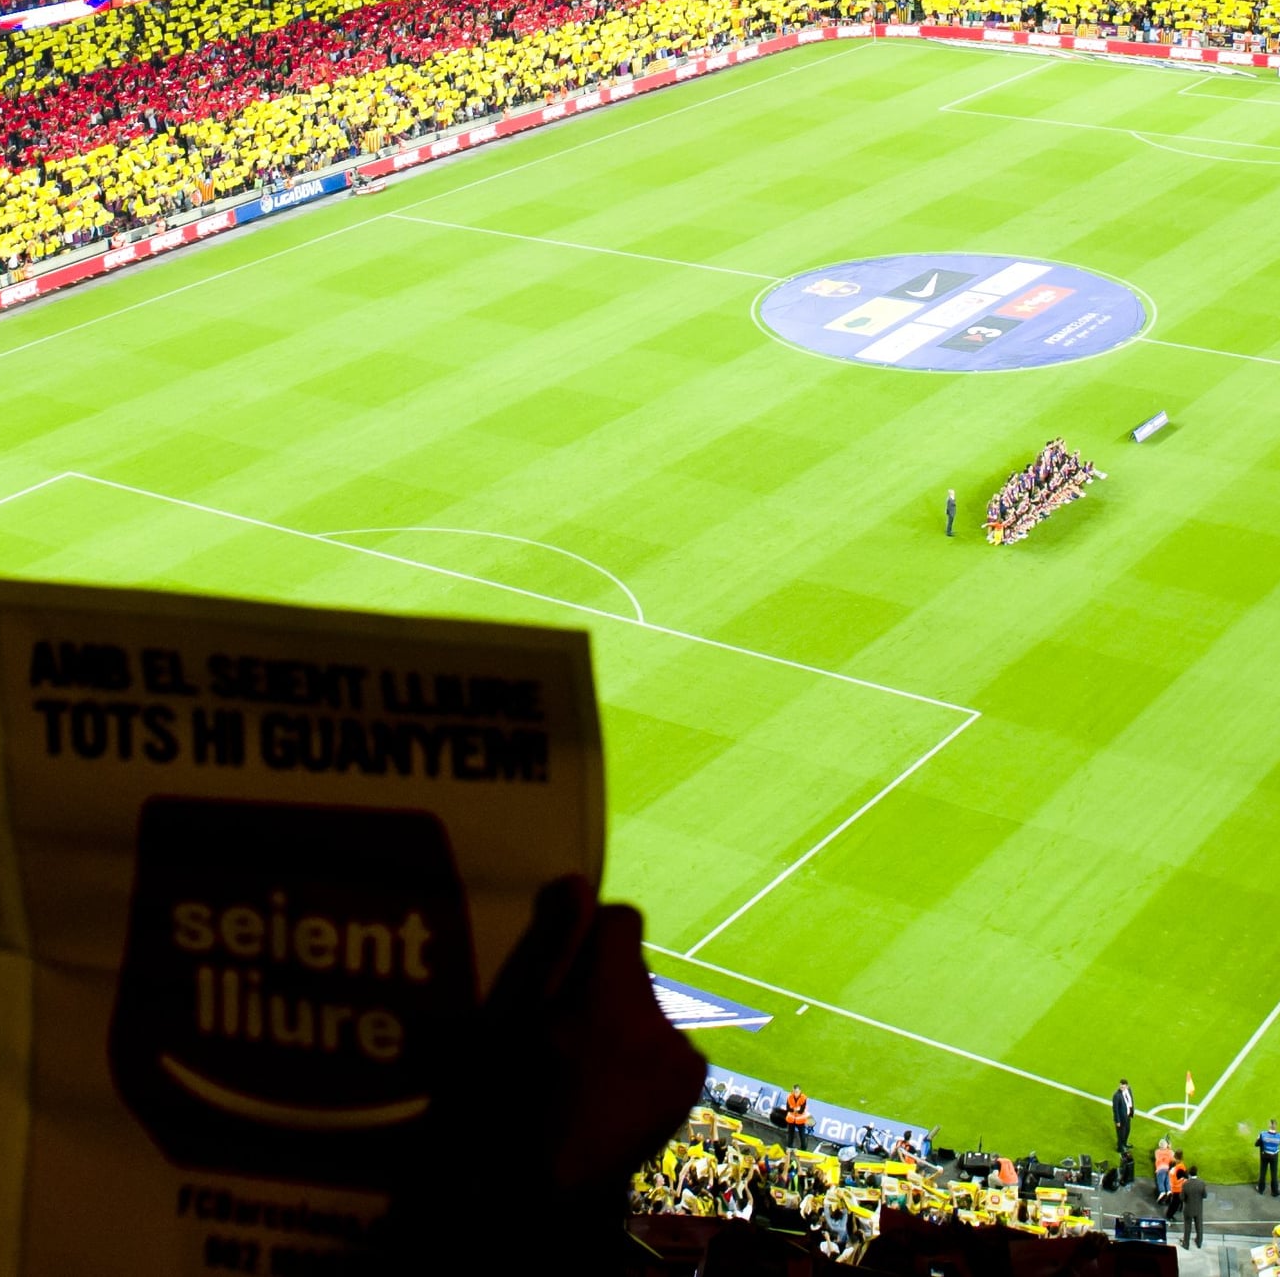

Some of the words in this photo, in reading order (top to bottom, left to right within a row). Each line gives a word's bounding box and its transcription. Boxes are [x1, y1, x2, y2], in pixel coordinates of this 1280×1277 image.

[272, 190, 297, 208] LIGA
[293, 180, 324, 201] BBVA
[30, 641, 130, 692] AMB
[140, 648, 201, 698] EL
[207, 652, 370, 711] SEIENT
[378, 668, 544, 720] LLIURE
[35, 700, 179, 764] TOTS
[192, 706, 245, 767] HI
[261, 712, 549, 784] GUANYEM!
[172, 887, 432, 982] seient
[197, 965, 404, 1064] lliure
